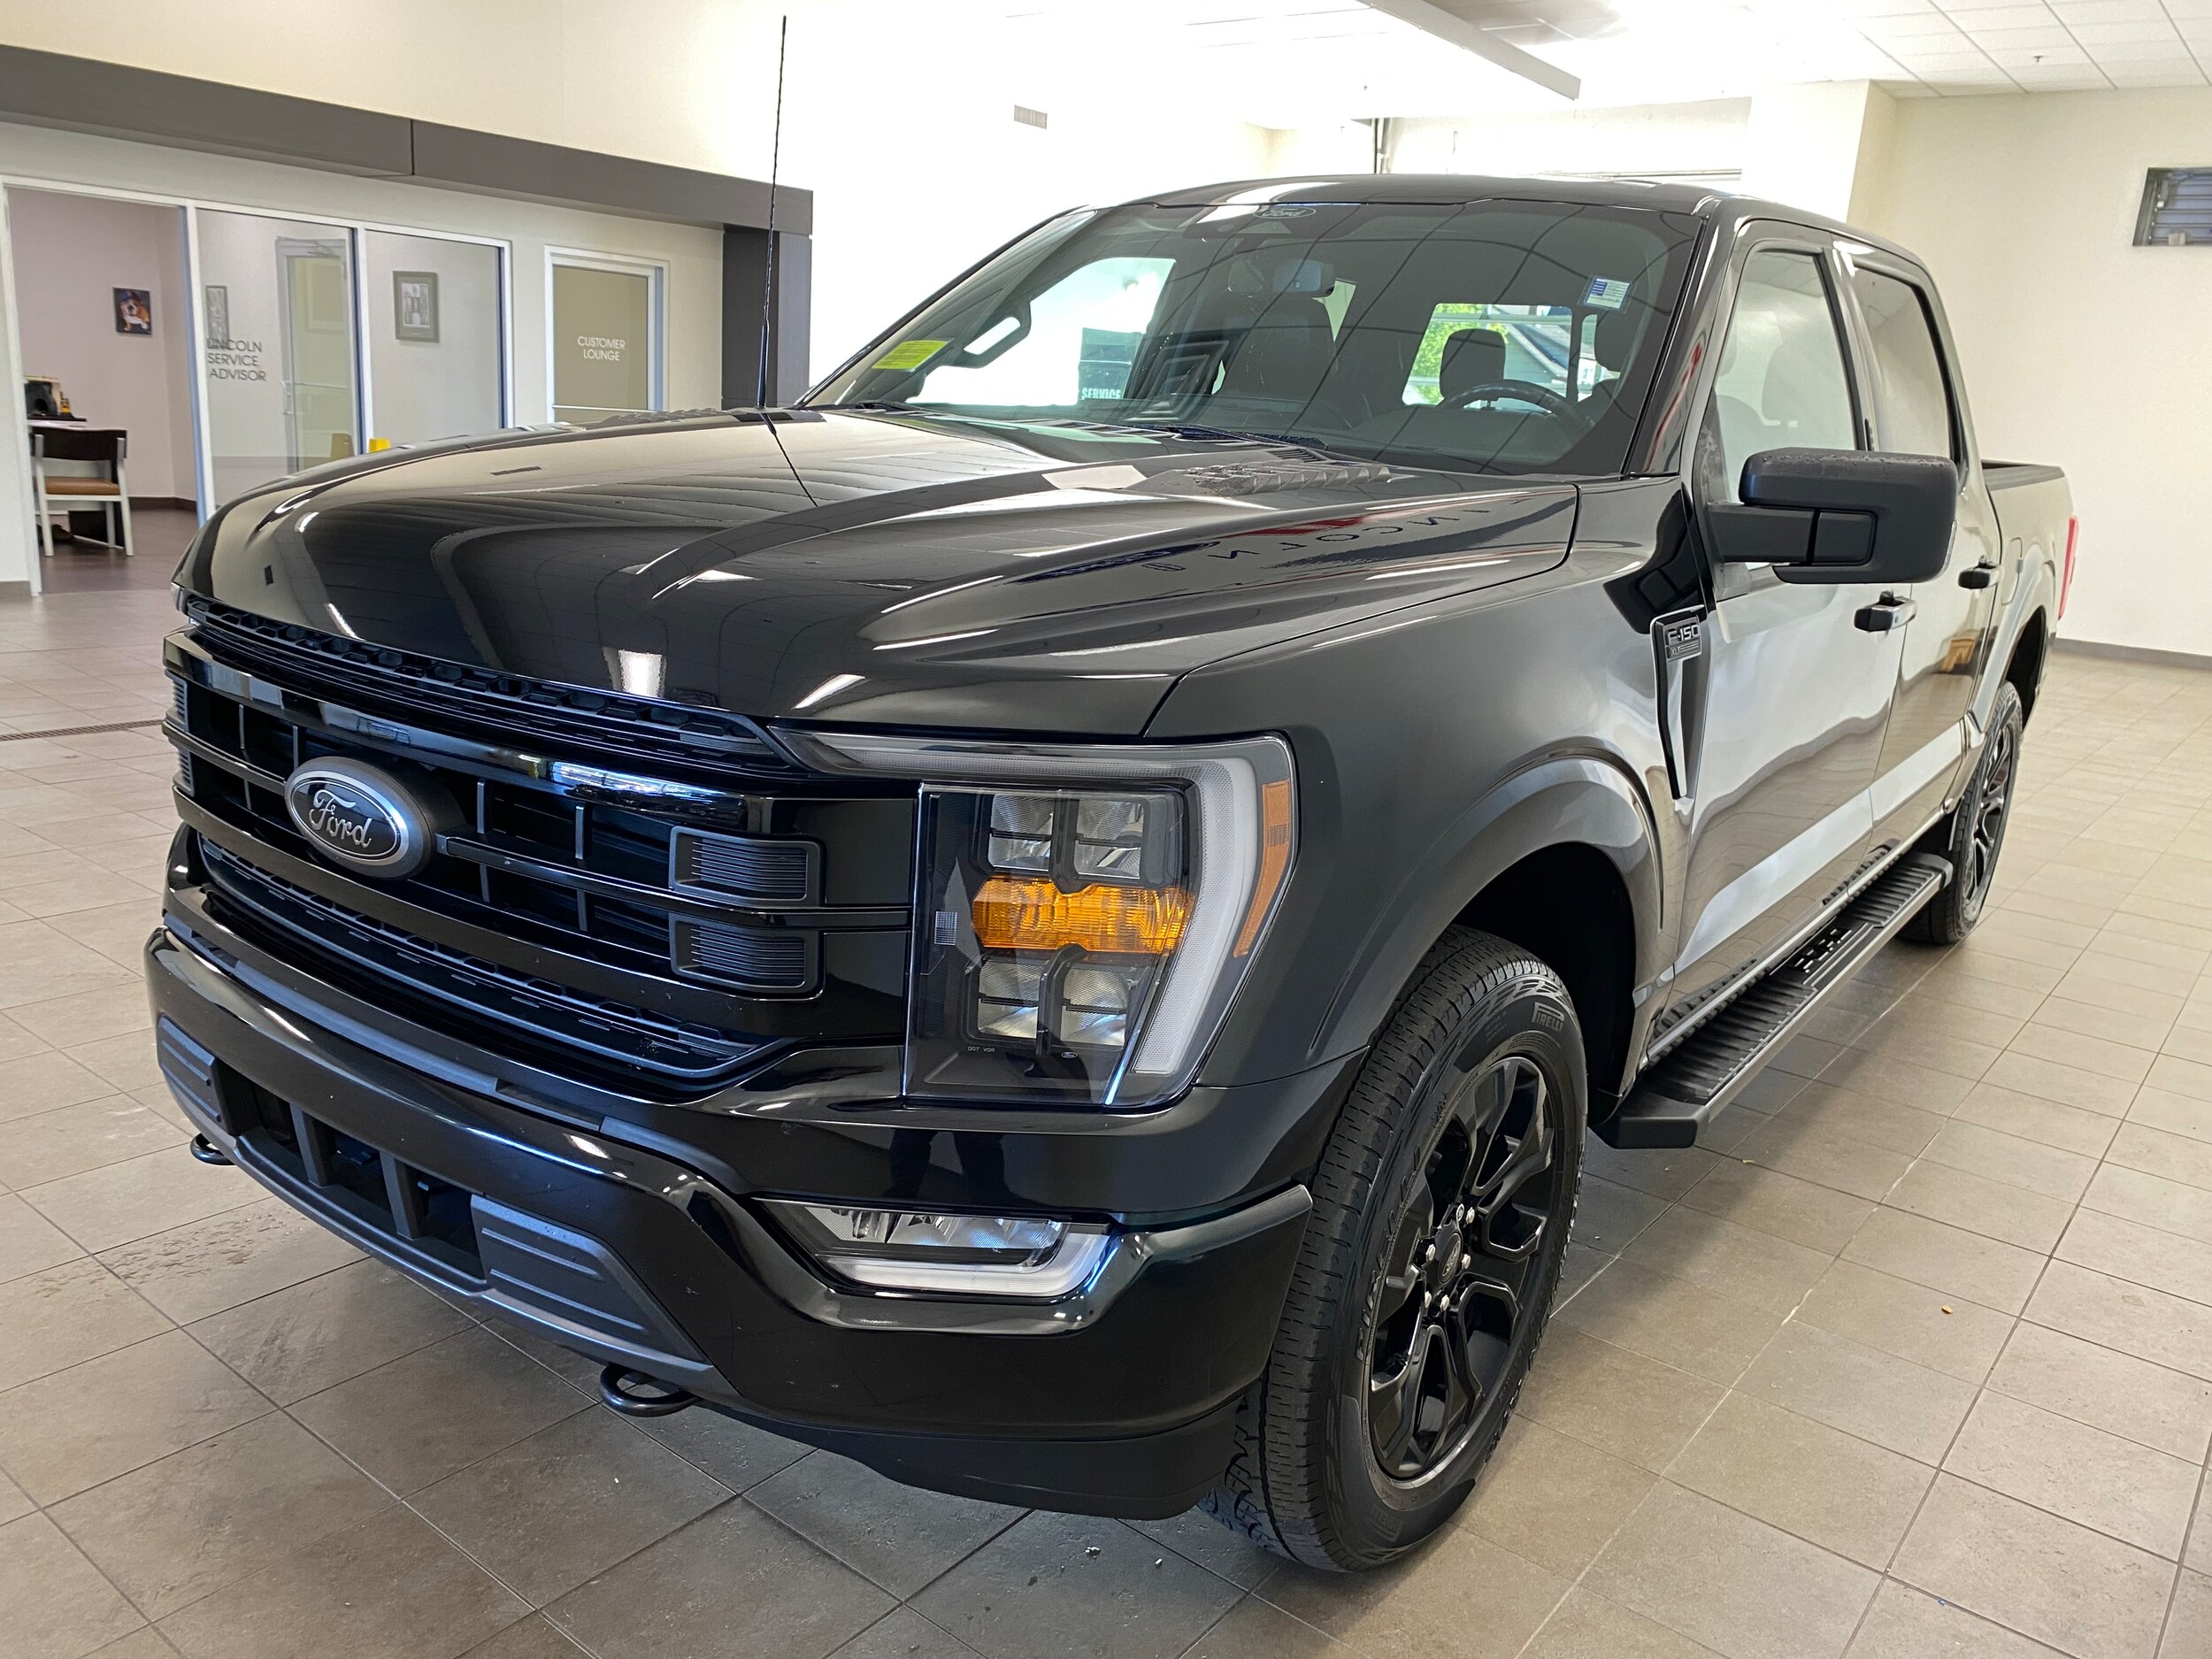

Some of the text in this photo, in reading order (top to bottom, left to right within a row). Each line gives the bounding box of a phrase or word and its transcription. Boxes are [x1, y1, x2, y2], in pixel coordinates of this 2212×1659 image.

[206, 338, 263, 352] LINCOLN
[577, 335, 626, 349] CUSTOMER
[207, 352, 258, 366] SERVICE
[583, 349, 620, 361] LOUNGE
[210, 368, 267, 381] ADVISOR
[1081, 388, 1122, 400] SERVICE
[309, 789, 373, 849] Ford
[1531, 1001, 1565, 1033] PIRELLI
[1355, 1144, 1422, 1363] PIRELLI
